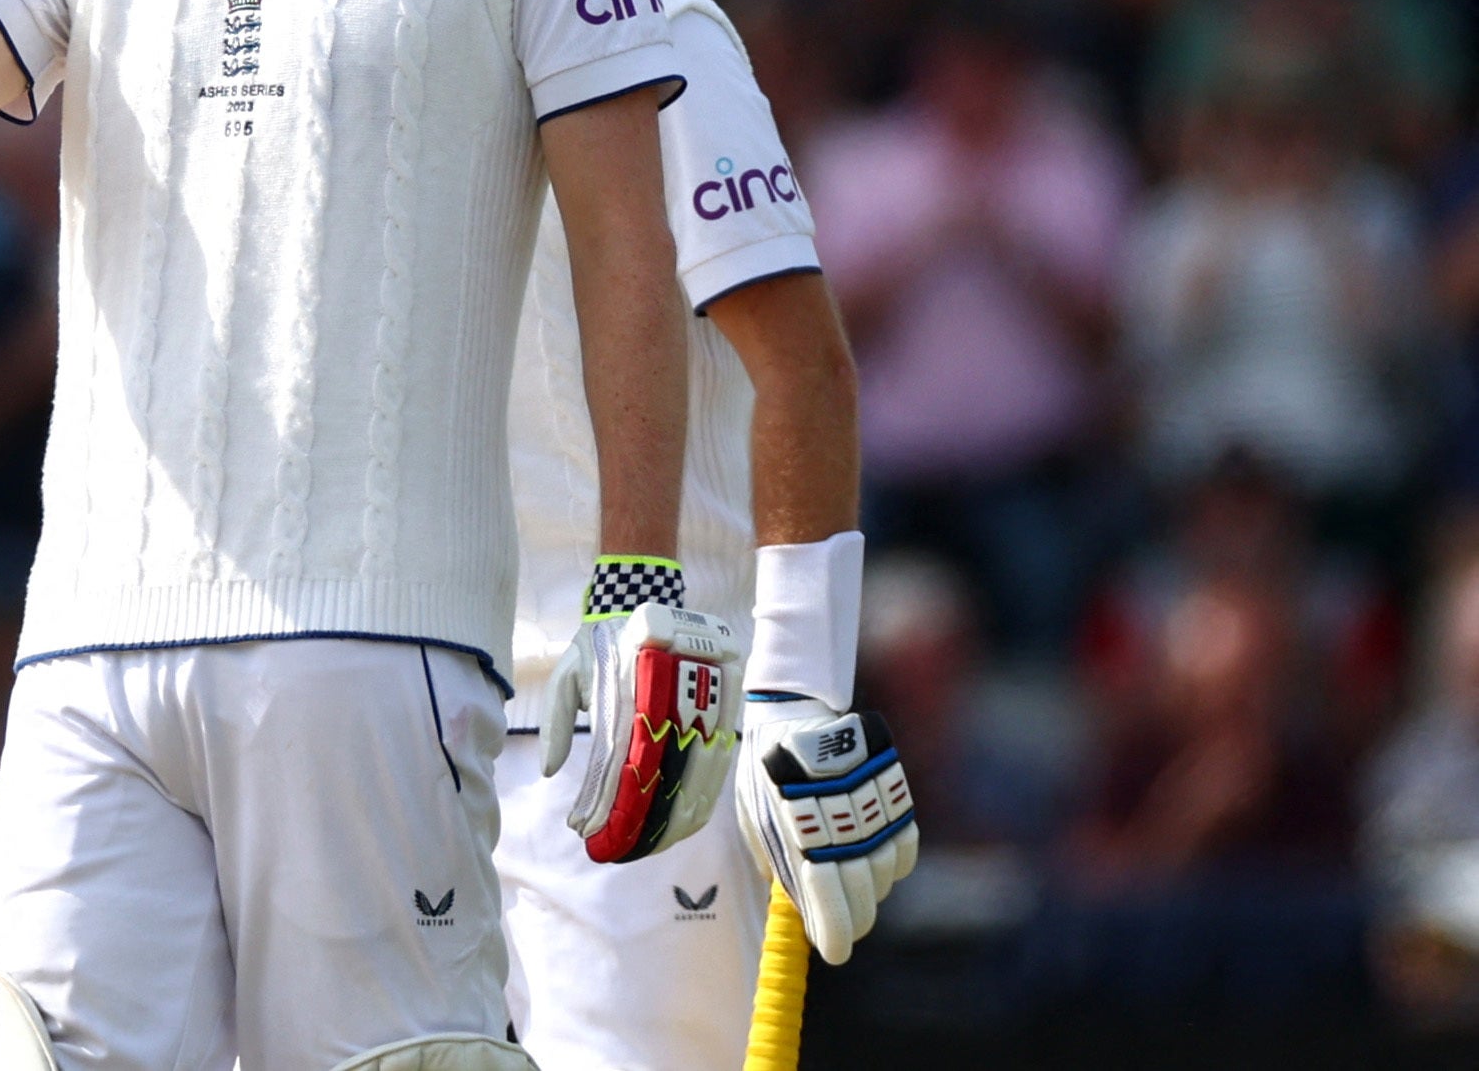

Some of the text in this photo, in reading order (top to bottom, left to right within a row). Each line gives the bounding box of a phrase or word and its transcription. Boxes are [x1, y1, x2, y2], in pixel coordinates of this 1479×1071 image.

[198, 84, 286, 99] ASHES SERIES
[226, 100, 254, 113] 2023
[224, 120, 254, 138] 695
